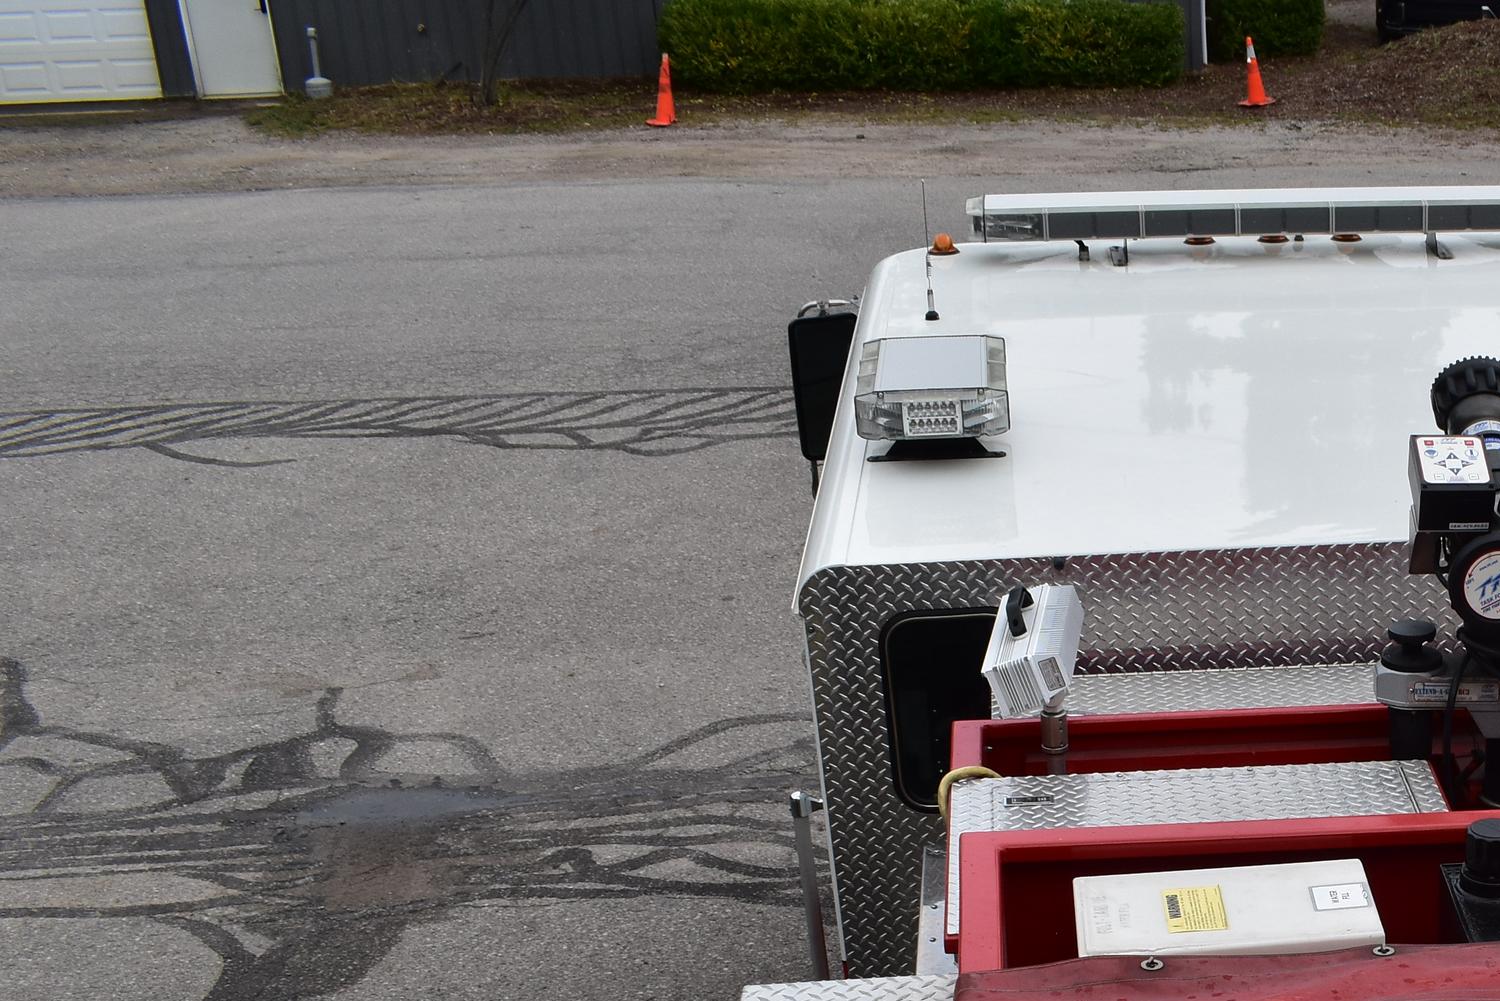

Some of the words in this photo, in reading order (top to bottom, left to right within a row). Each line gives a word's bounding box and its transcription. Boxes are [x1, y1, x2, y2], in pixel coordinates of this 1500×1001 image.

[1480, 597, 1494, 606] TASK
[1328, 890, 1340, 904] WATER
[1342, 892, 1350, 900] FILL
[1166, 894, 1182, 920] WARNING
